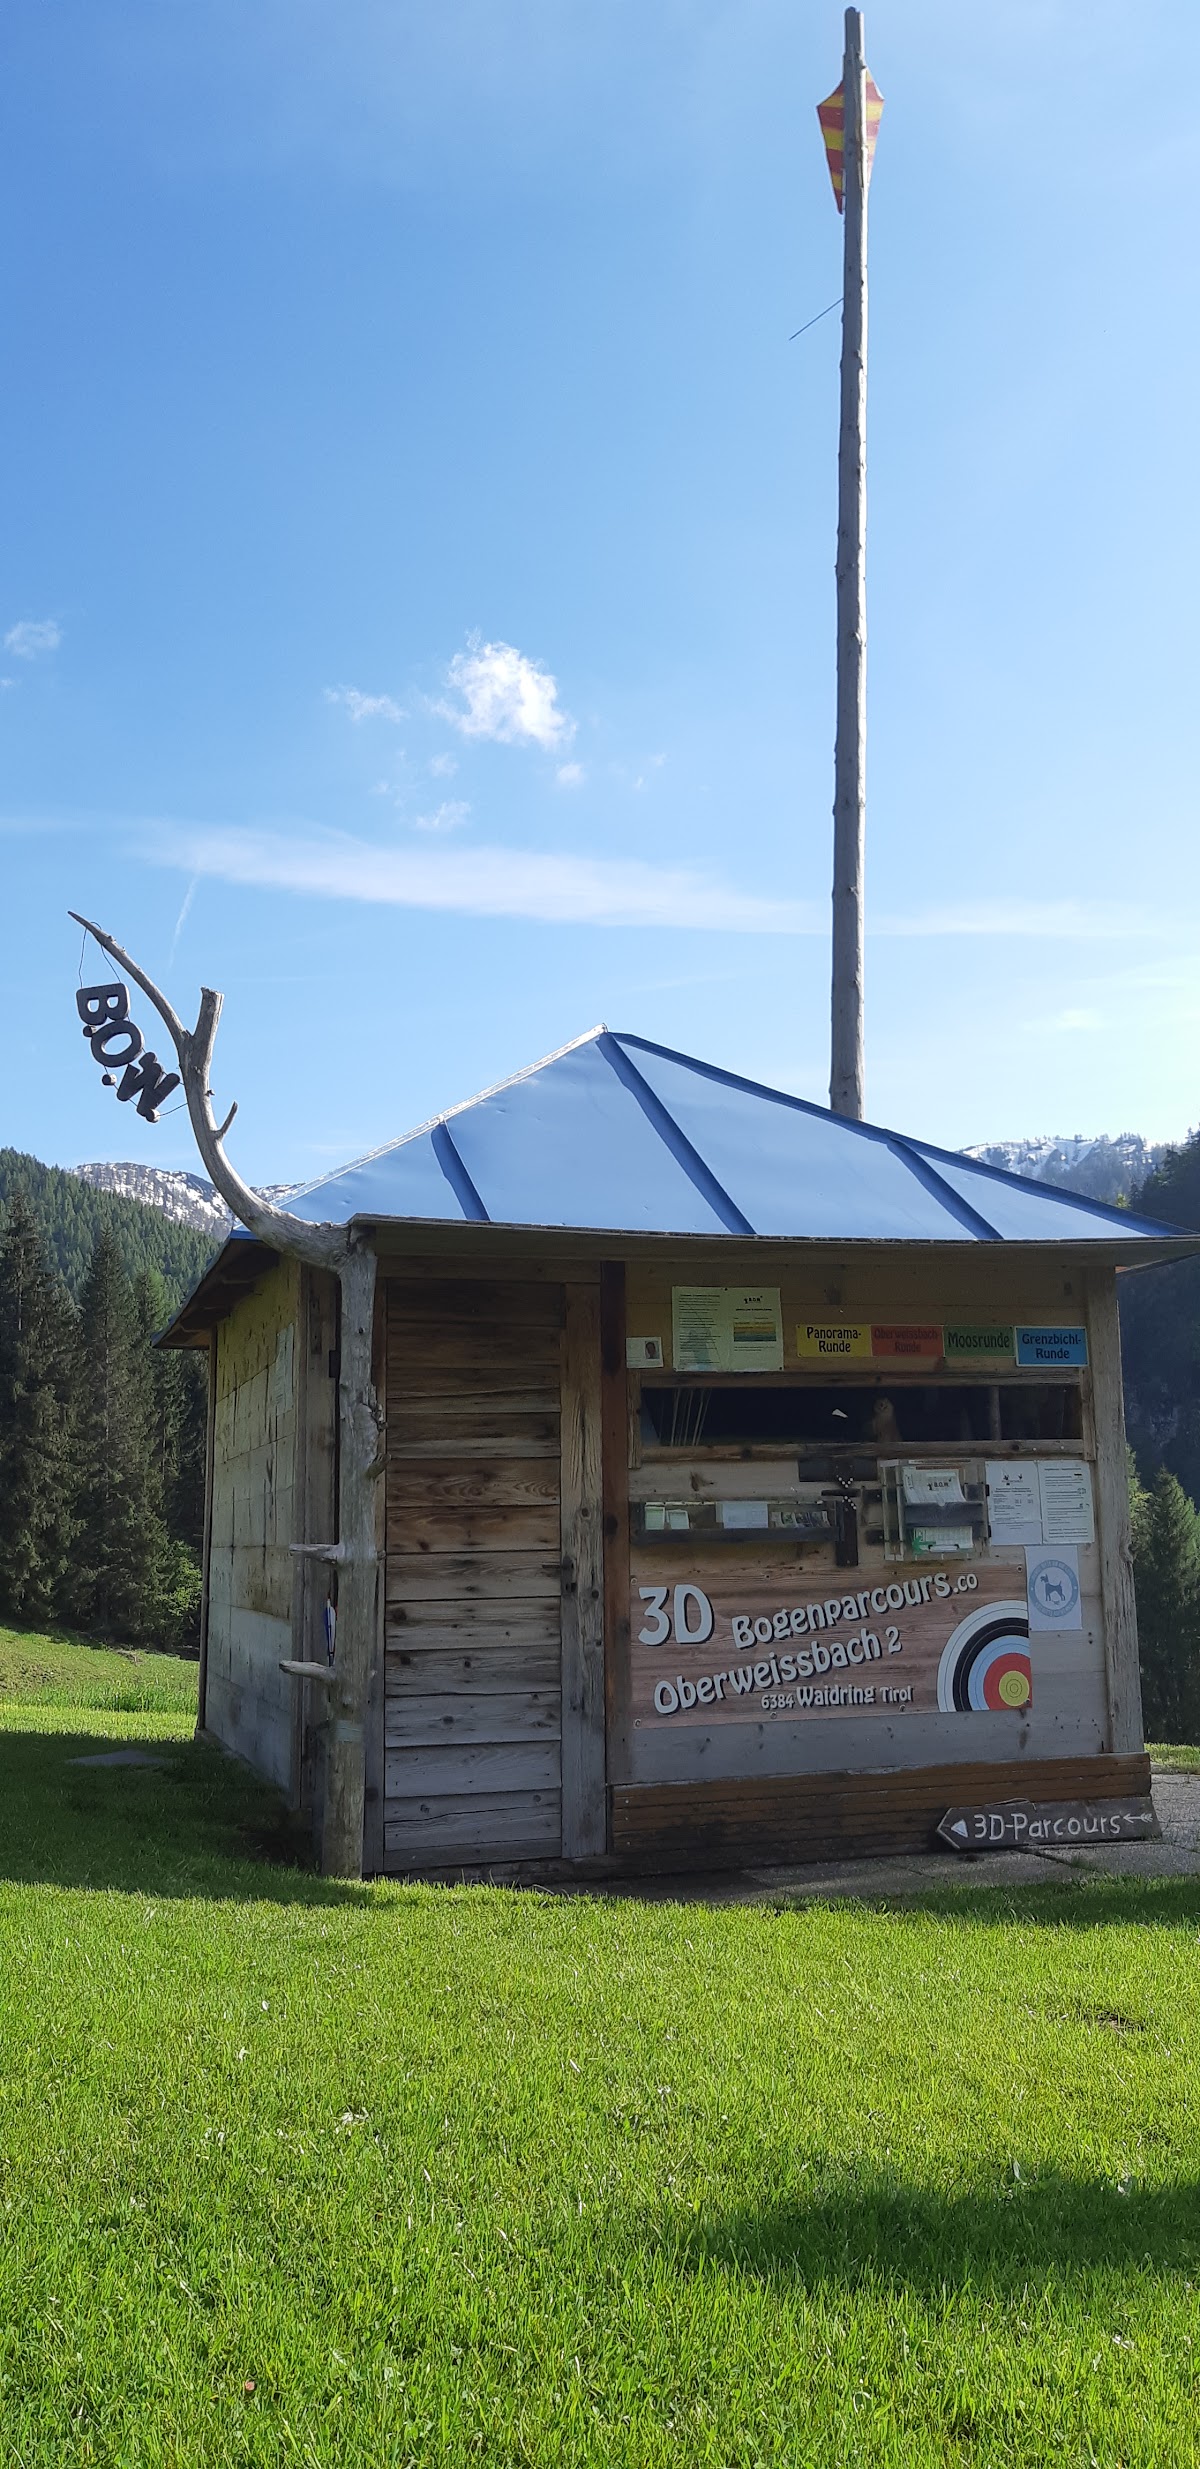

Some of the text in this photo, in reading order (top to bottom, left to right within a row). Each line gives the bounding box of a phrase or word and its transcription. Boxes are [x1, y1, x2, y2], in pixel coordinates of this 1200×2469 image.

[806, 1326, 861, 1339] Panorama-
[1021, 1333, 1082, 1346] Grenzbichl-
[818, 1340, 851, 1353] Runde
[894, 1341, 922, 1353] Runde
[947, 1332, 1010, 1348] Moosrunde
[1035, 1347, 1070, 1359] Runde
[637, 1584, 715, 1646] 3D
[653, 1625, 903, 1715] Oberweissbach 2
[760, 1684, 914, 1710] 6384 Waidring Tirol
[973, 1813, 1122, 1841] 3D-Parcours
